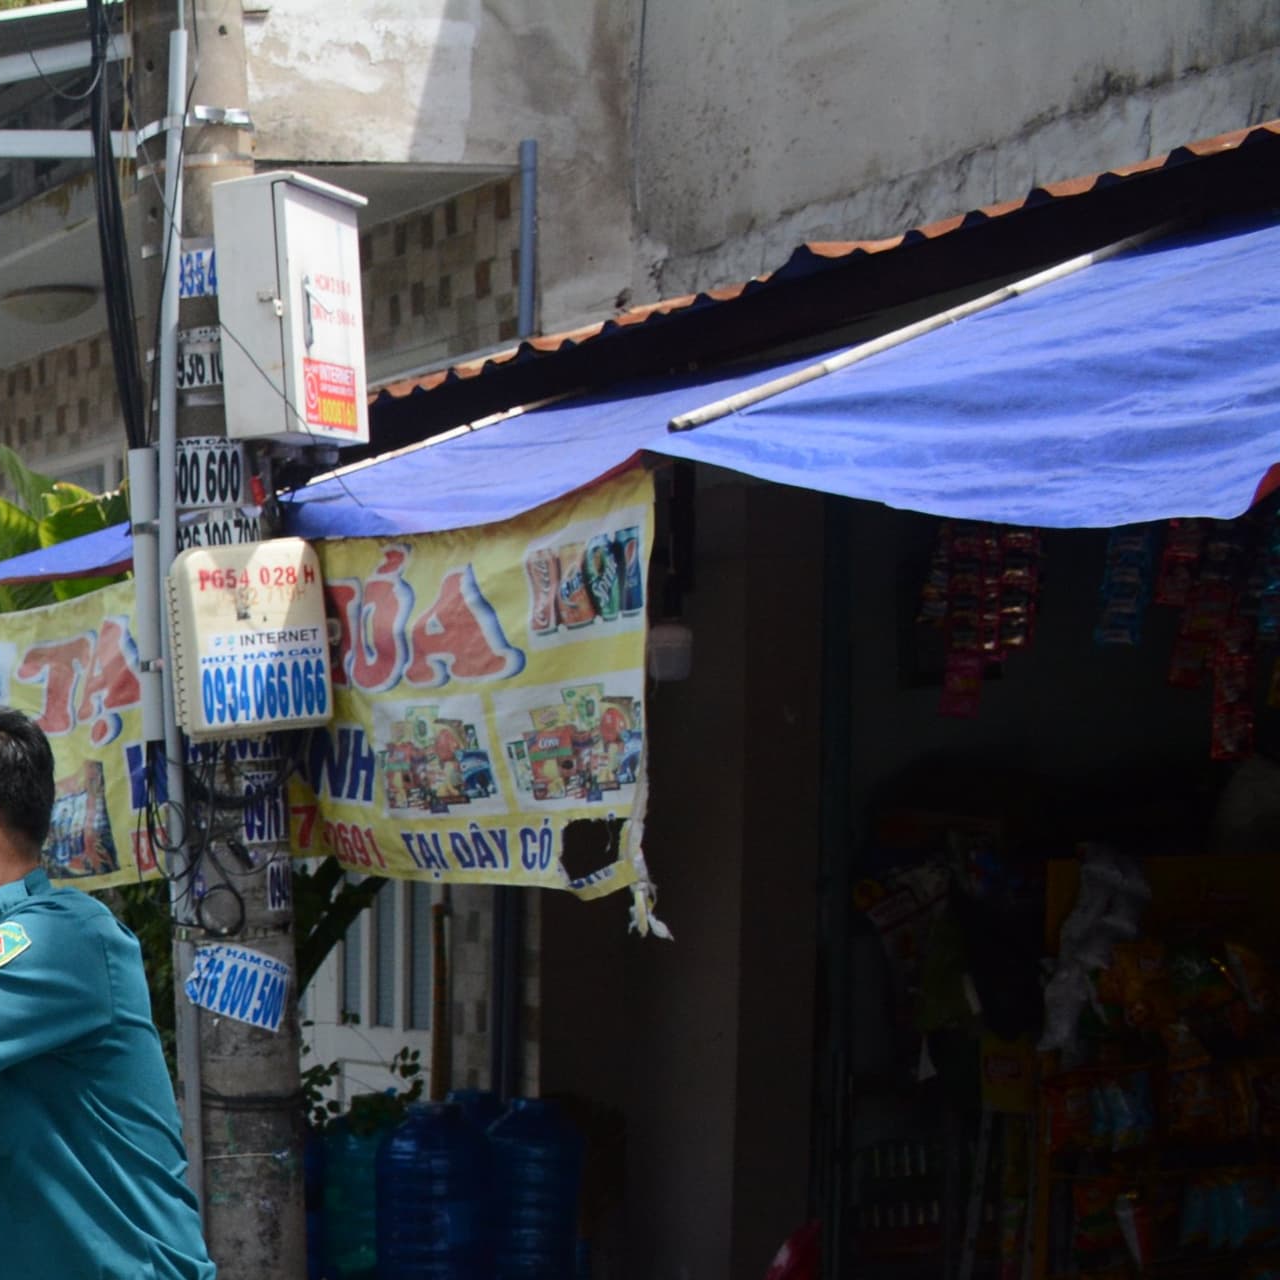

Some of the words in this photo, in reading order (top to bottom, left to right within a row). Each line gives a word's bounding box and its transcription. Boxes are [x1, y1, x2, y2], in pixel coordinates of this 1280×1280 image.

[259, 565, 298, 586] 028
[303, 565, 316, 585] H
[239, 628, 320, 647] INTERNET
[202, 658, 327, 726] 0934.066.066
[401, 832, 449, 878] TẠI
[519, 818, 554, 870] CÓ
